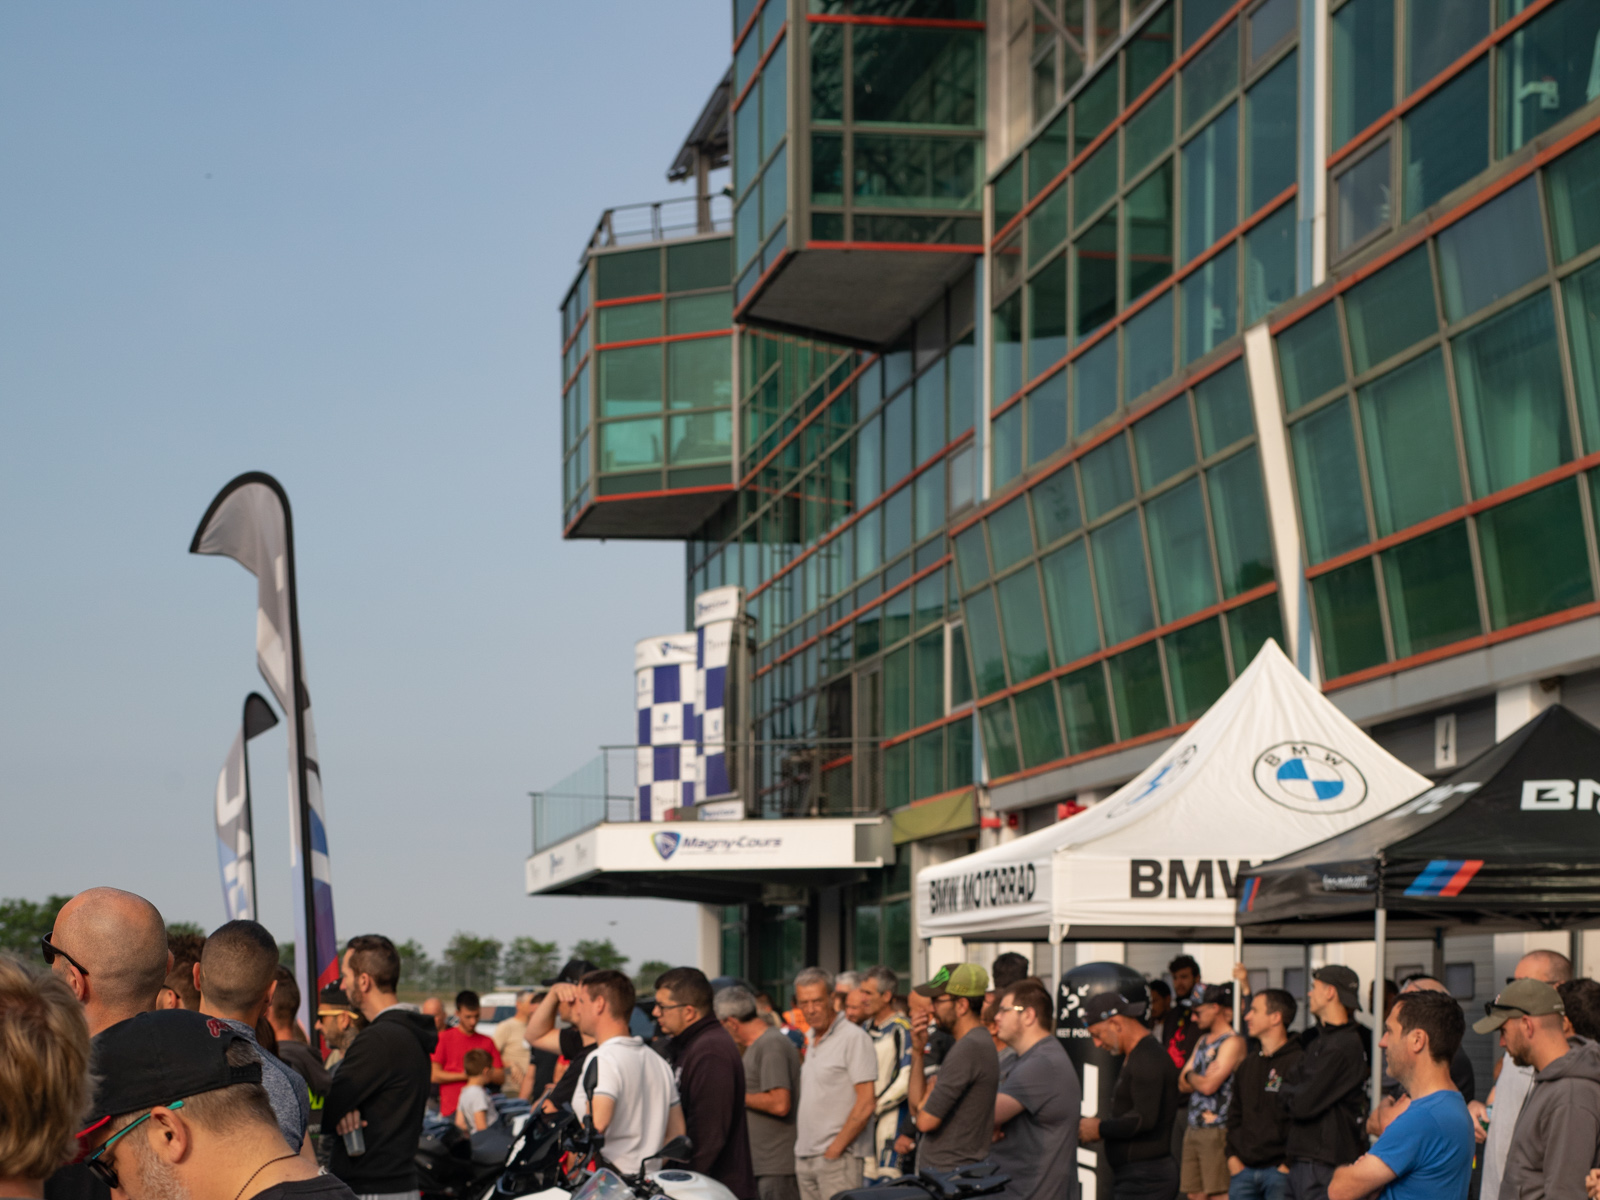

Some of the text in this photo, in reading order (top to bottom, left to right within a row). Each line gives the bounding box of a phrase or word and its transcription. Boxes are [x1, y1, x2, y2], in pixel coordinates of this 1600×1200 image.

[1264, 745, 1343, 767] BMW
[683, 836, 782, 852] Magny-Cours
[930, 863, 1036, 915] BMW MOTORRAD
